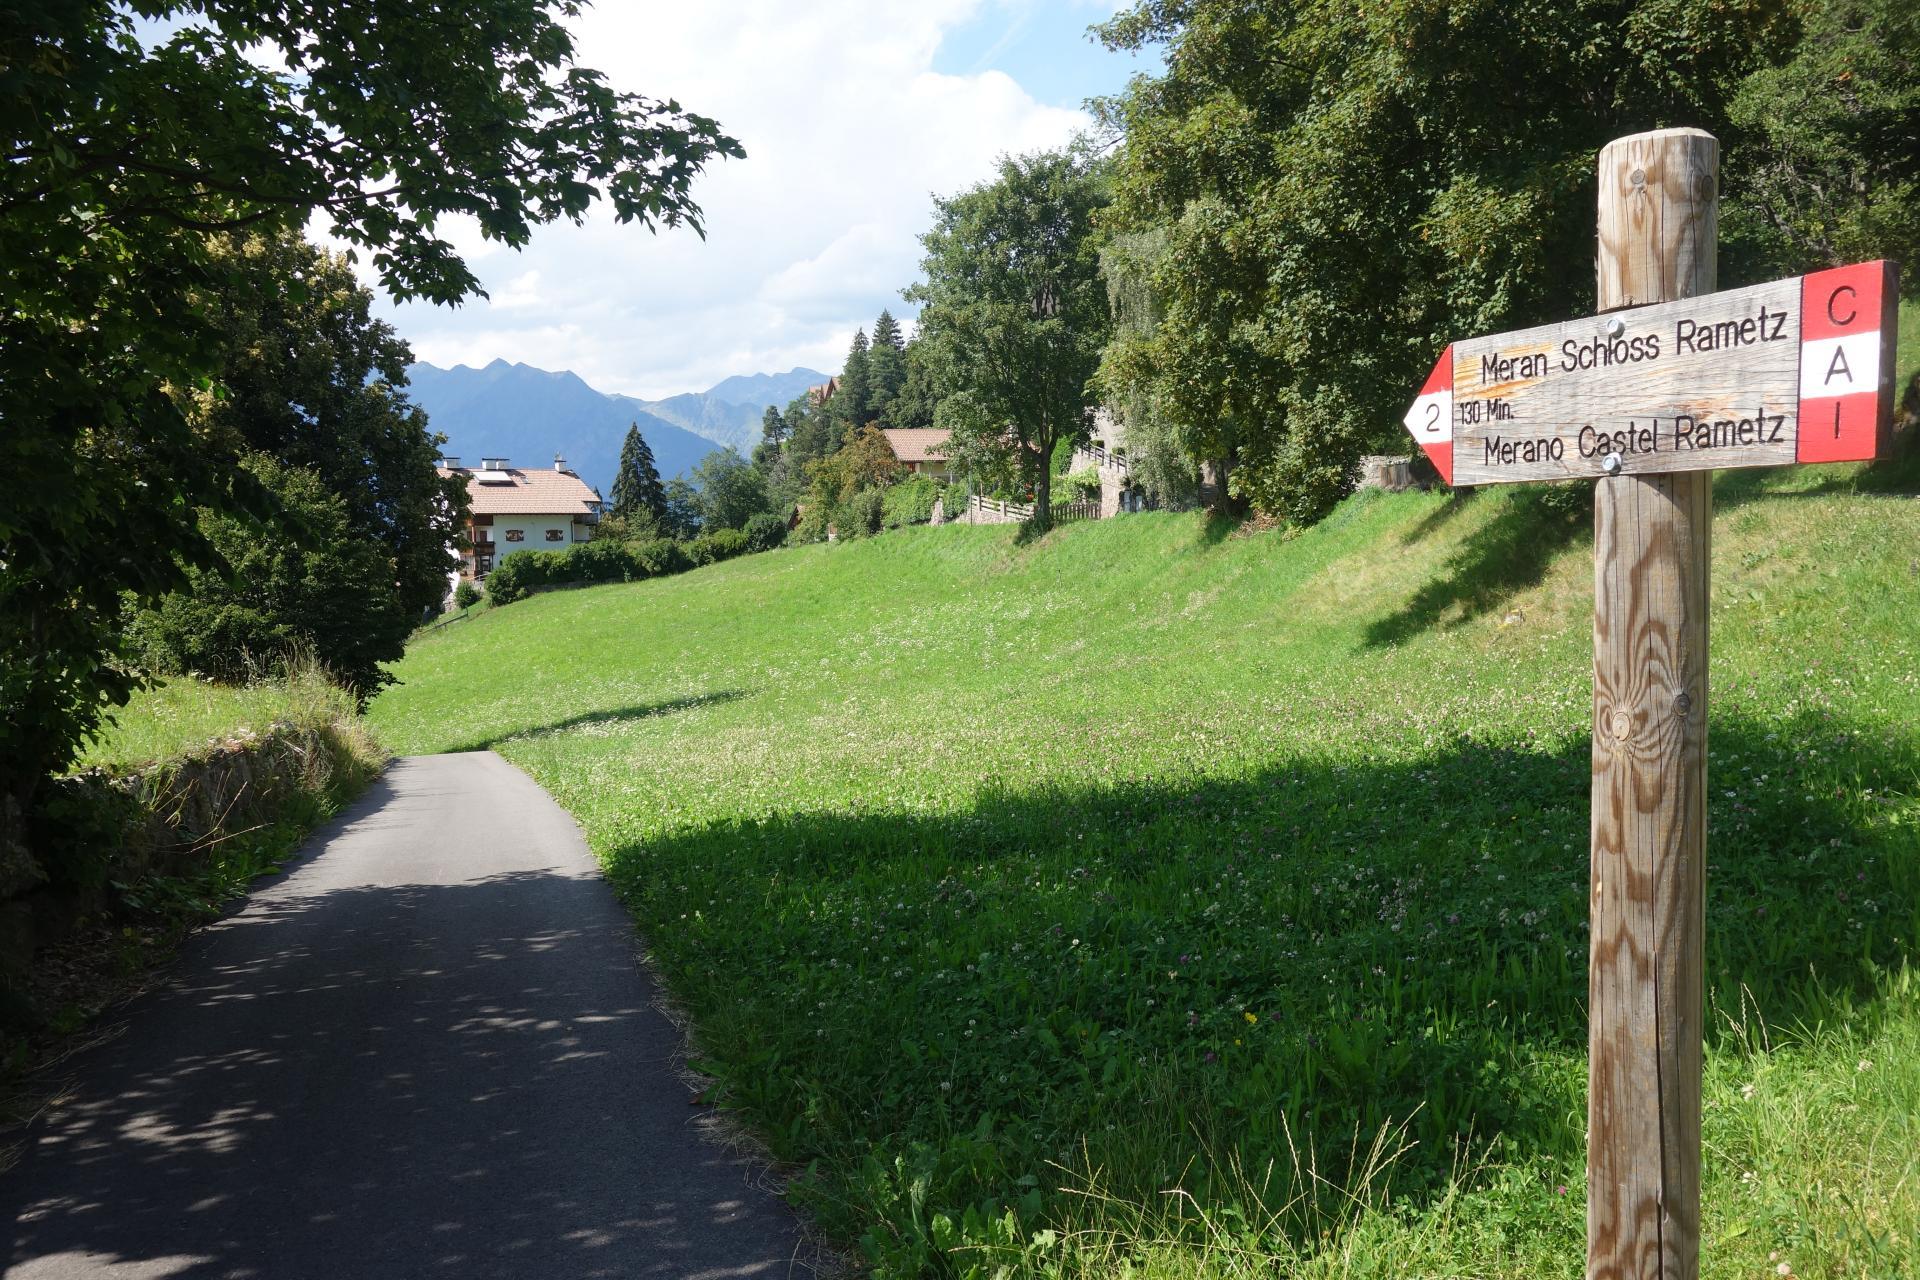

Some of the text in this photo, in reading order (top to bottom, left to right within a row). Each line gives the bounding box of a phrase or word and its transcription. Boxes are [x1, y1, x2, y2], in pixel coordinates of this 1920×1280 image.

[1482, 305, 1788, 384] Meran Schloss Rametz
[1425, 403, 1440, 432] 2
[1459, 398, 1514, 425] 130 Min.
[1485, 407, 1785, 466] Merano Castel Rametz
